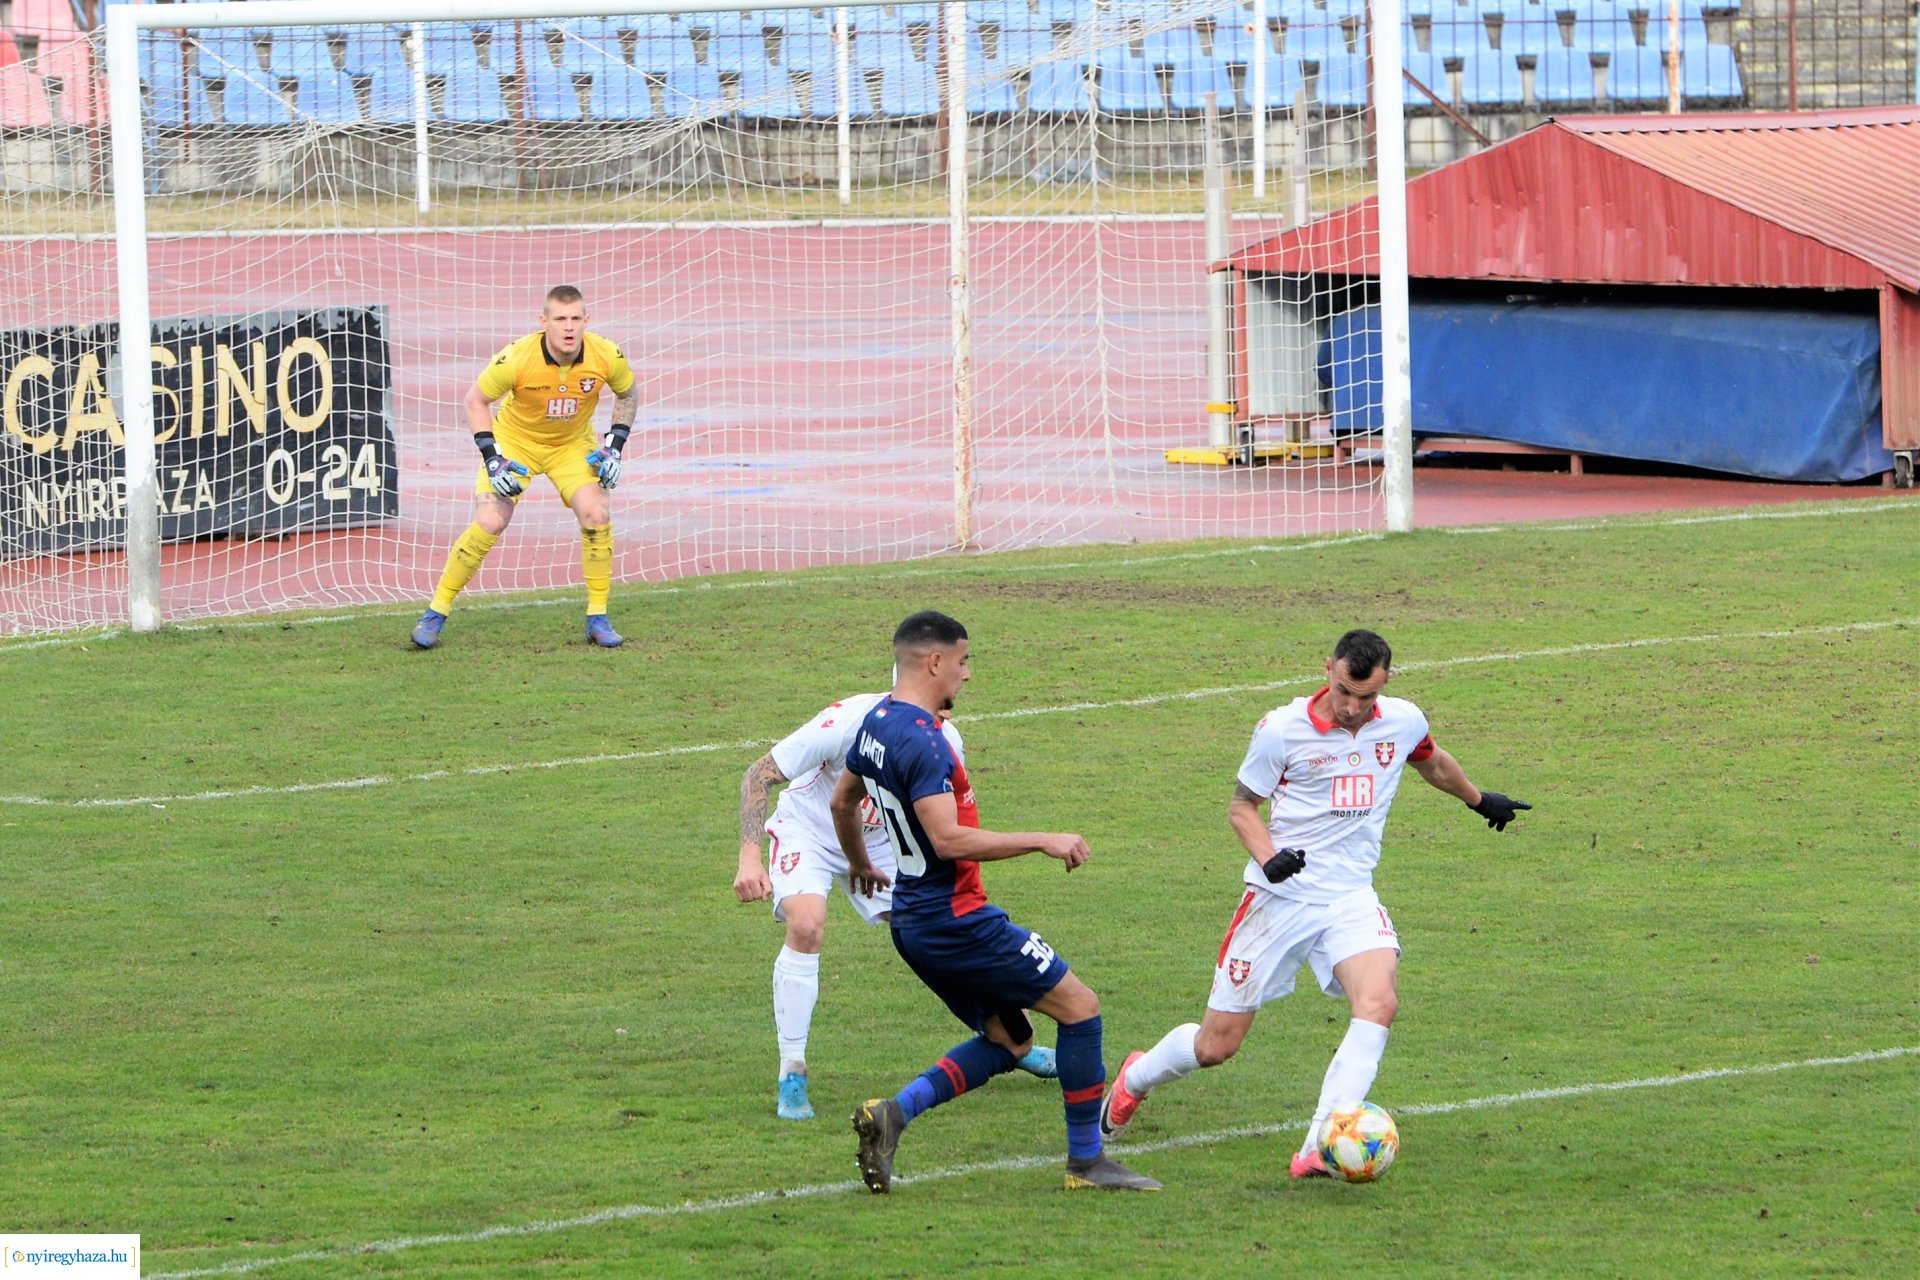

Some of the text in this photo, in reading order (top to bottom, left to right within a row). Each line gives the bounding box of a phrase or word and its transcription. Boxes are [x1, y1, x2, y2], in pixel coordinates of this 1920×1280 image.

[5, 336, 333, 454] CASINO
[548, 398, 577, 415] HR
[25, 443, 381, 528] NYÍRPÁZA 0-24
[1334, 775, 1371, 806] HR
